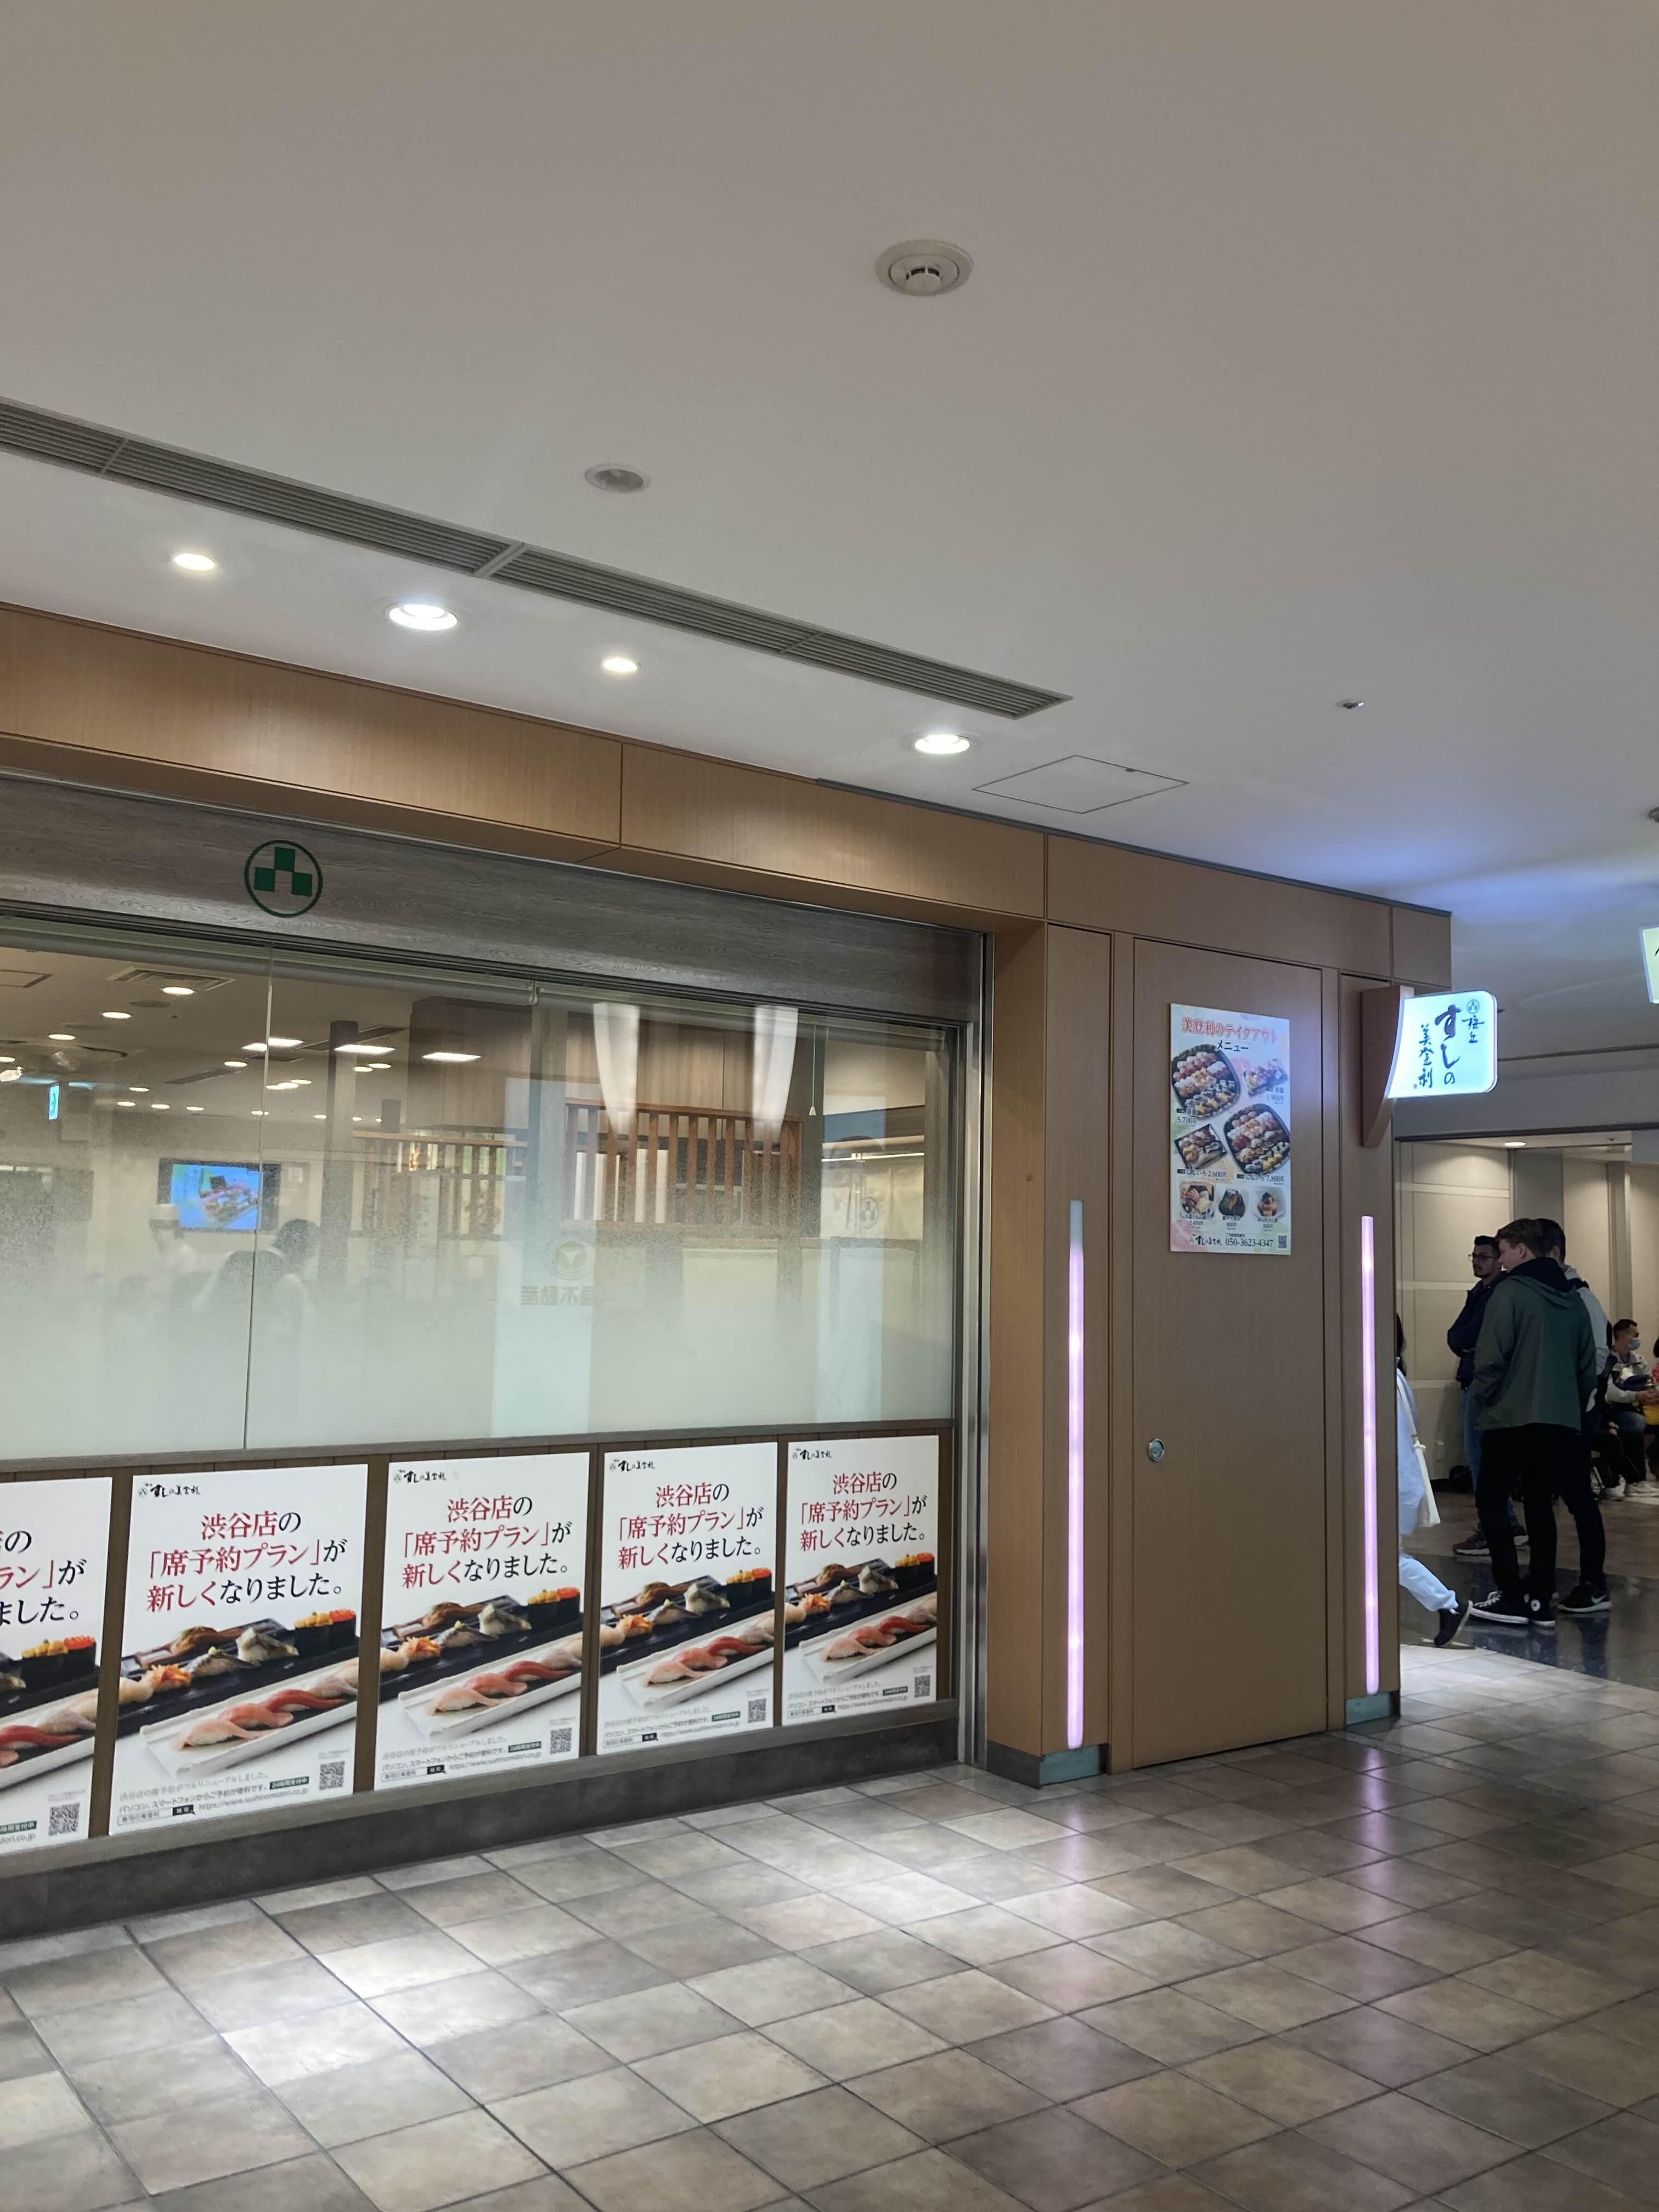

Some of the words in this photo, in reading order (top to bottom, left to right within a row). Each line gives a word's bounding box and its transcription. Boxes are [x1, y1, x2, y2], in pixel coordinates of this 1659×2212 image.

[1216, 1040, 1249, 1052] メニュー
[1434, 1004, 1462, 1085] すしの
[1226, 1238, 1273, 1247] 050-3623-4347
[657, 1482, 729, 1508] 渋谷店の
[833, 1471, 896, 1494] 渋谷店の
[448, 1495, 532, 1522] 渋谷店の
[801, 1495, 927, 1526] 「席予約プラン」が
[201, 1510, 301, 1541] 渋谷店の
[404, 1522, 572, 1557] 「席予約プラン」が
[618, 1508, 763, 1541] 「席予約プラン」が
[800, 1522, 925, 1551] 新しくなりました。
[150, 1539, 347, 1577] 「席予約プラン」が
[618, 1536, 761, 1570] 新しくなりました。
[402, 1554, 568, 1588] 新しくなりました。
[146, 1573, 342, 1612] 新しくなりました。
